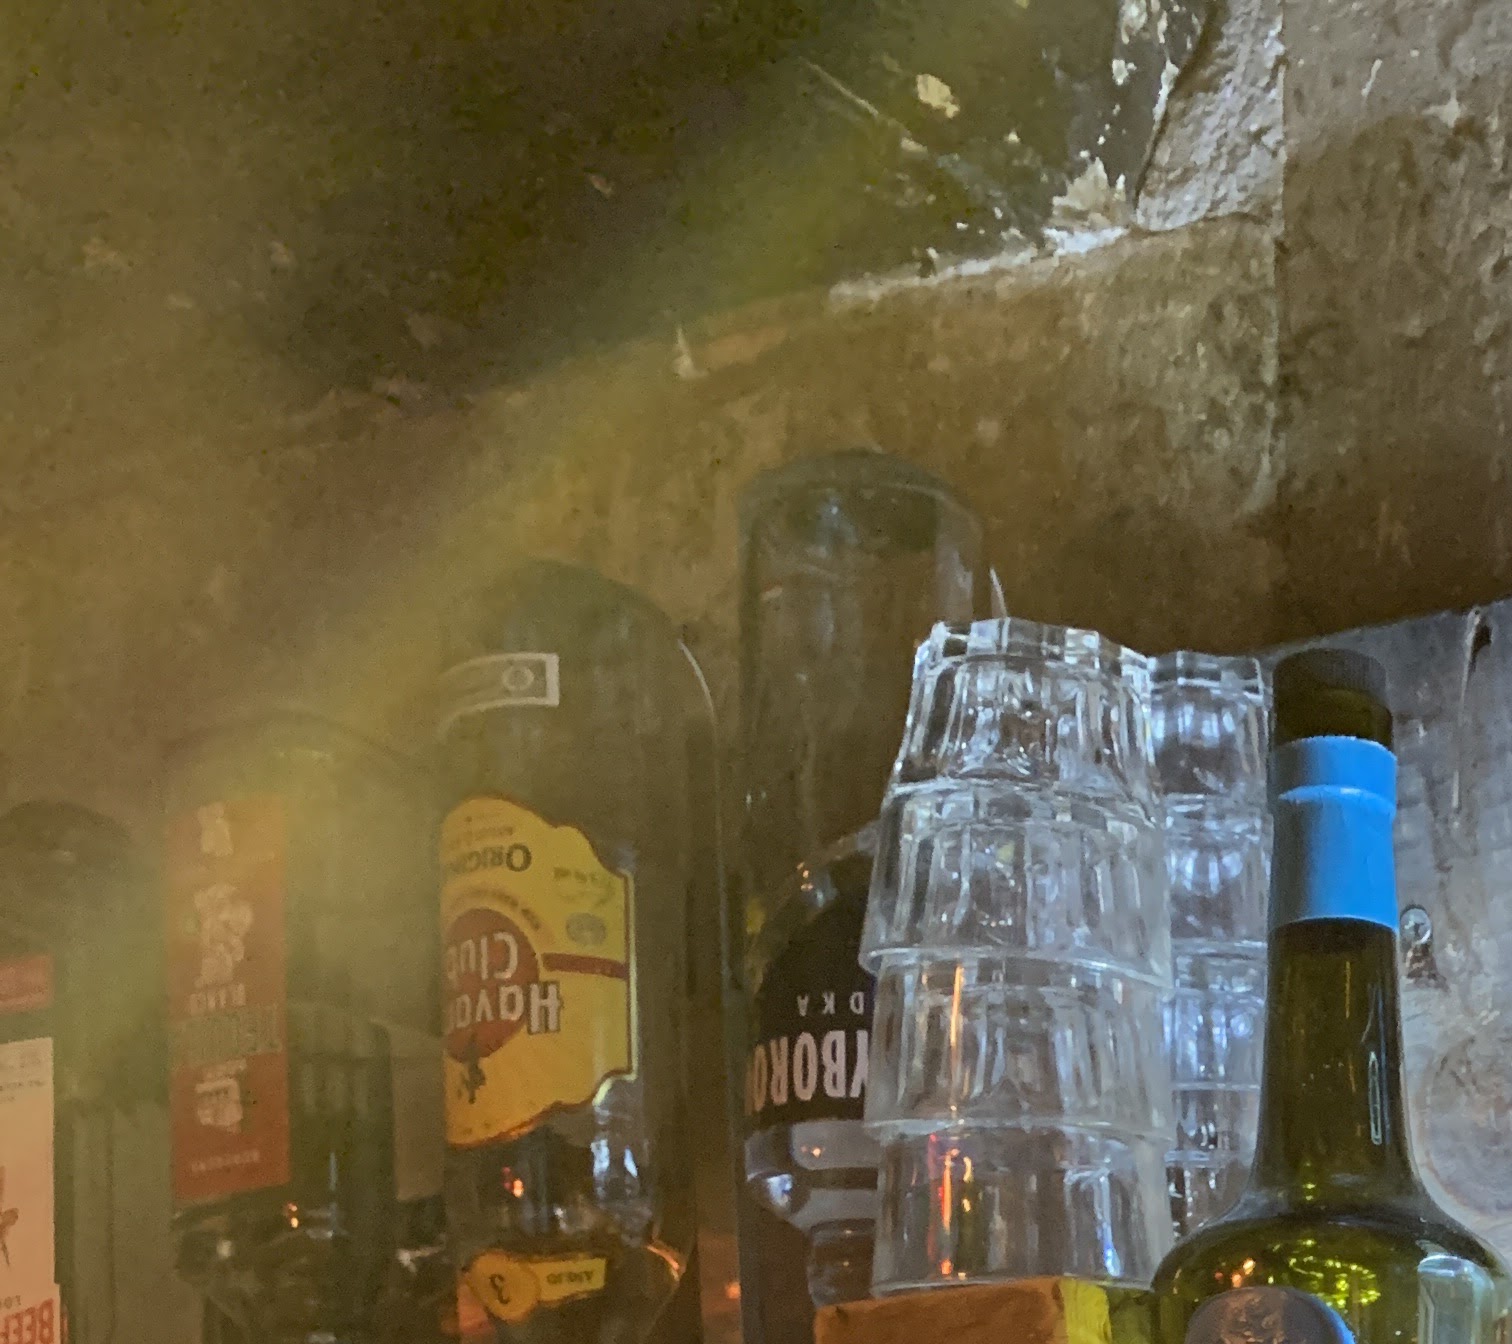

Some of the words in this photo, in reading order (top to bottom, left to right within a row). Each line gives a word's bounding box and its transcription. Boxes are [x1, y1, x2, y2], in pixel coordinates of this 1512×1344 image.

[447, 979, 562, 1036] Hava
[796, 991, 866, 1016] DKA
[744, 1028, 870, 1117] YBORO
